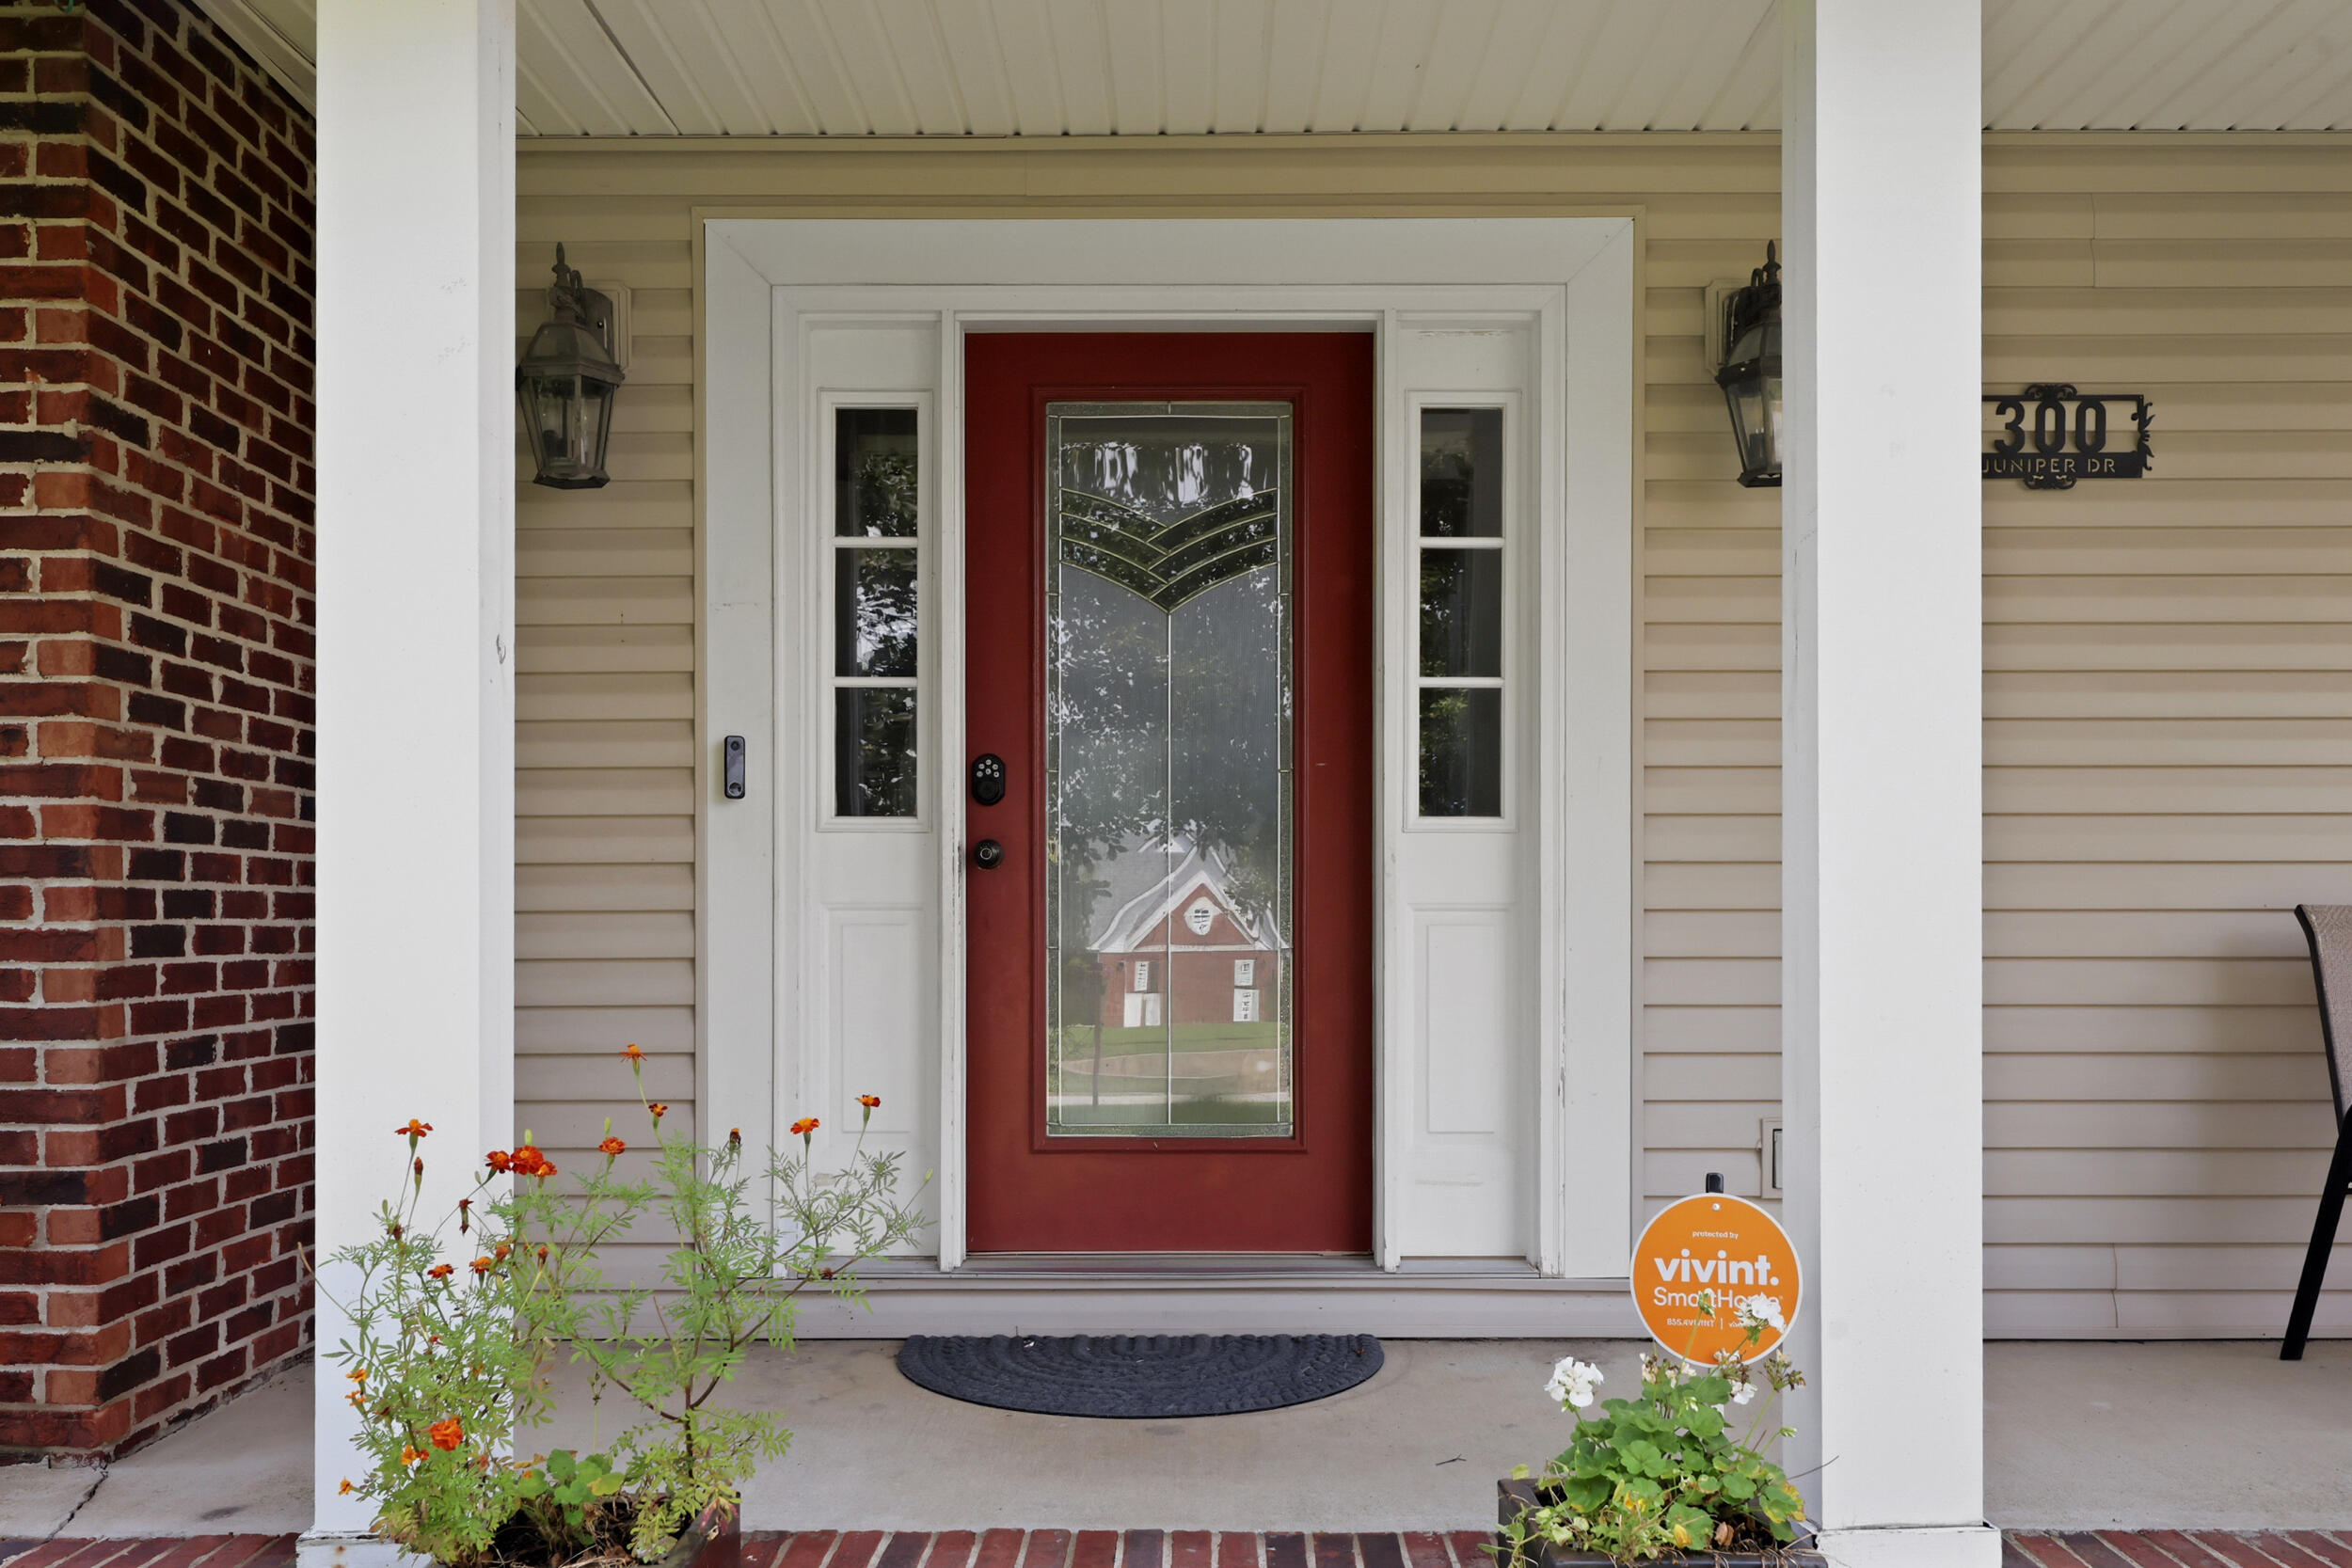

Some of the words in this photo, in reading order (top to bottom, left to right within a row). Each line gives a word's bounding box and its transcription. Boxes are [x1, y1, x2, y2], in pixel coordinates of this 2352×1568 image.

[1994, 400, 2106, 453] 300
[1982, 458, 2076, 473] JUNIPER
[2088, 458, 2116, 473] DR
[1729, 1231, 1739, 1240] by
[1654, 1248, 1779, 1286] vivint.
